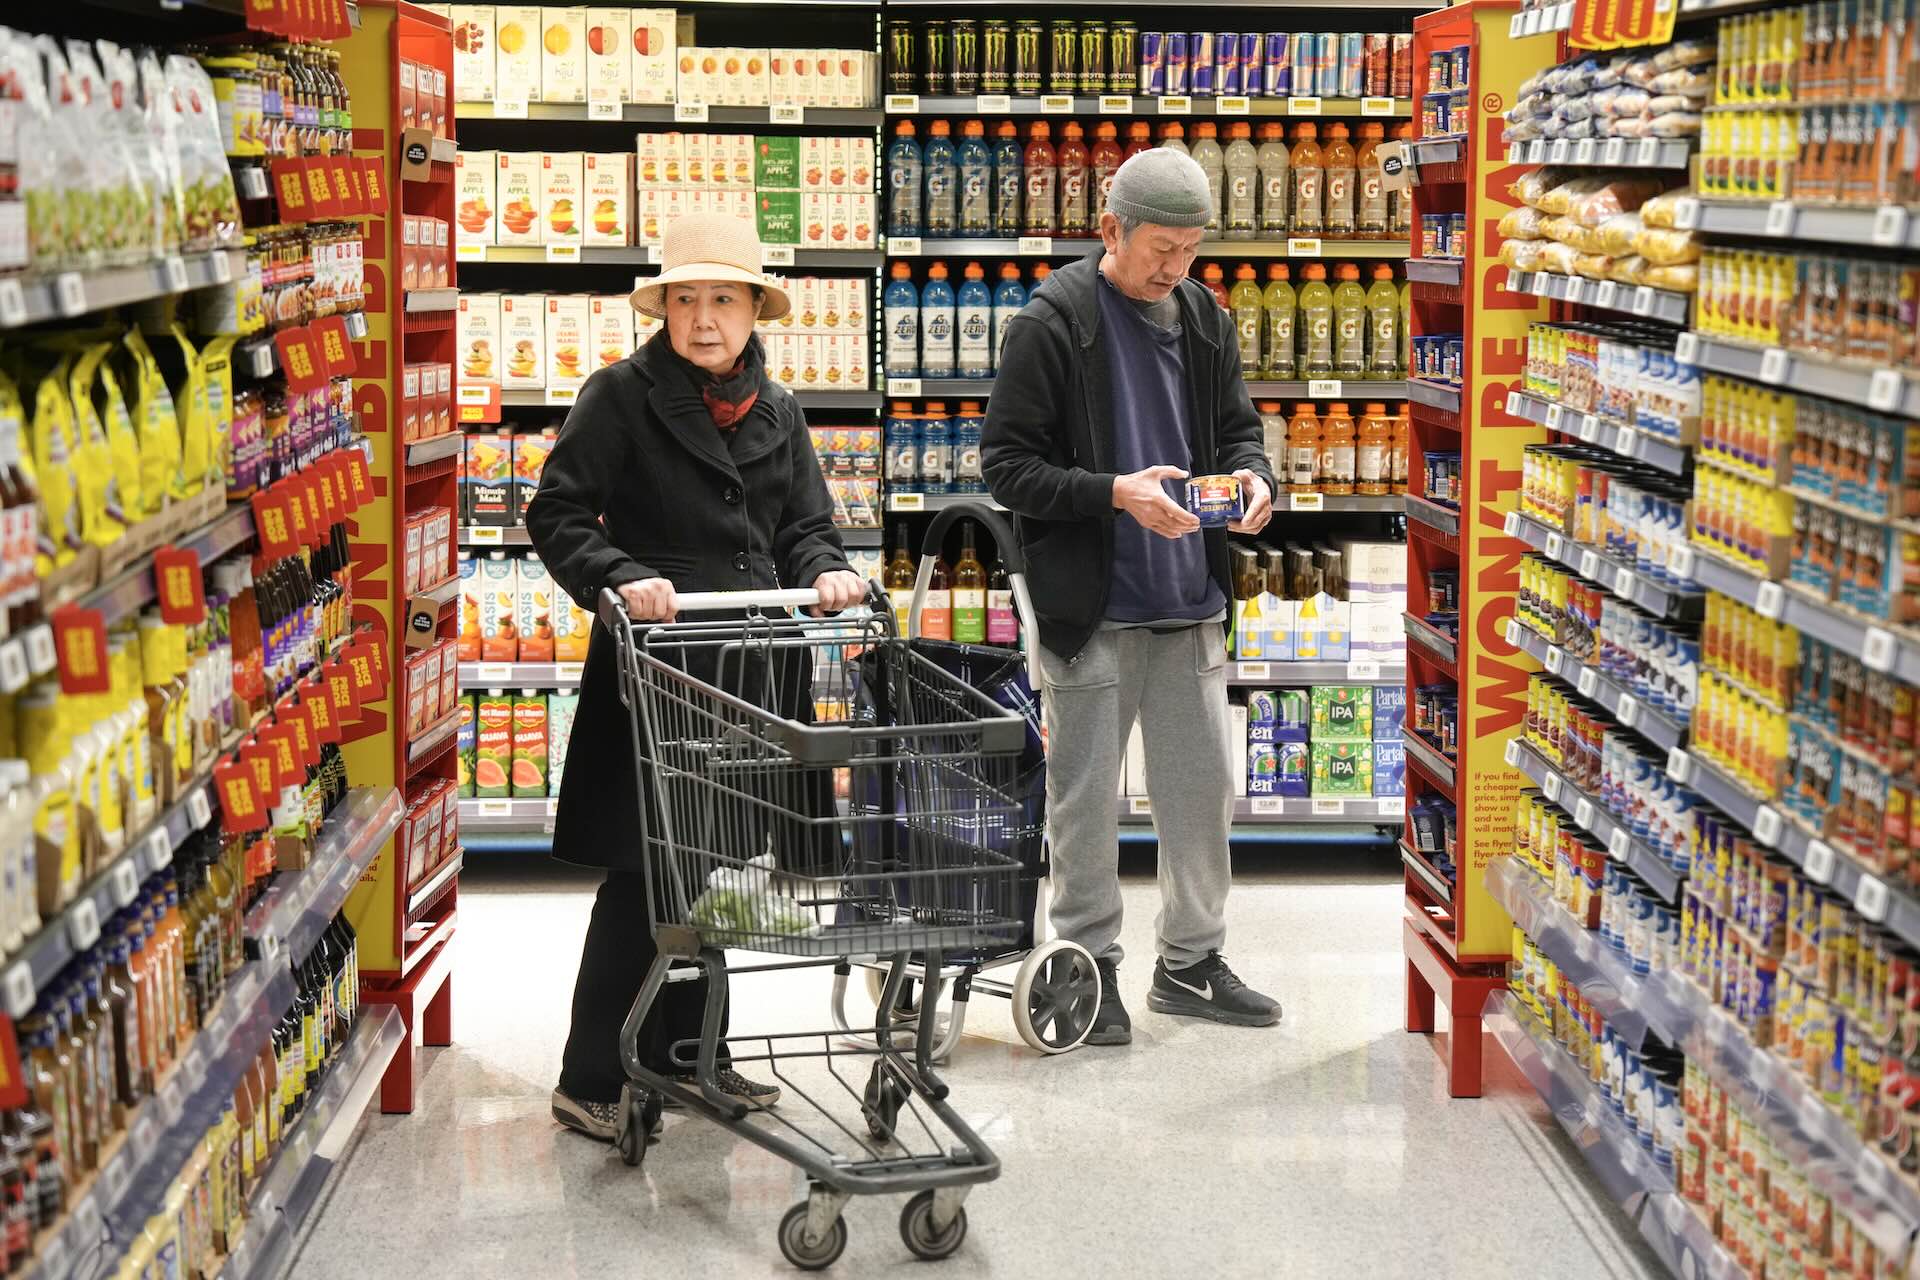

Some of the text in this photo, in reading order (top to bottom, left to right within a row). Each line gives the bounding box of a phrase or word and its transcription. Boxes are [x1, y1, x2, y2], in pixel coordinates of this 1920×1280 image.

[316, 168, 331, 200] PRICE
[334, 168, 351, 198] PRICE
[368, 170, 380, 199] PRICE
[891, 169, 905, 188] G
[928, 176, 943, 196] G
[967, 176, 981, 196] G
[1004, 176, 1018, 196] G
[1028, 176, 1042, 196] G
[1065, 176, 1081, 197] G
[1232, 177, 1246, 198] G
[1268, 177, 1281, 198] G
[1301, 178, 1316, 198] G
[1330, 178, 1344, 199] G
[1364, 178, 1379, 199] G
[768, 221, 789, 230] APPLE
[963, 325, 986, 334] ZERO
[1242, 319, 1256, 338] G
[1276, 318, 1291, 338] G
[1314, 318, 1328, 338] G
[1341, 319, 1356, 338] G
[1378, 318, 1392, 338] G
[899, 452, 913, 467] G
[923, 451, 937, 467] G
[960, 450, 977, 467] G
[1322, 450, 1334, 468] G
[350, 461, 364, 492] PRICE
[475, 486, 506, 495] Minute
[479, 494, 502, 502] Maid
[521, 486, 538, 495] Min
[1476, 460, 1533, 738] WON'T
[484, 592, 496, 638] OASIS
[521, 592, 533, 638] OASIS
[371, 642, 382, 670] PRICE
[350, 658, 363, 688] DROP
[359, 656, 372, 686] PRICE
[340, 676, 350, 706] PRICE
[1376, 688, 1406, 706] Partak
[307, 697, 320, 730] DROP
[317, 696, 330, 728] PRICE
[1332, 707, 1353, 718] IPA
[480, 732, 509, 742] GUAVA
[514, 732, 544, 742] GUAVA
[1377, 744, 1406, 762] Partak
[1332, 762, 1354, 774] IPA
[1483, 774, 1500, 783] you
[1502, 772, 1520, 780] find
[1483, 784, 1518, 793] cheaper
[1474, 794, 1520, 804] price, simp
[1474, 804, 1497, 812] show
[1474, 824, 1490, 833] will
[1474, 839, 1512, 850] See flyer
[1474, 850, 1494, 860] flyer
